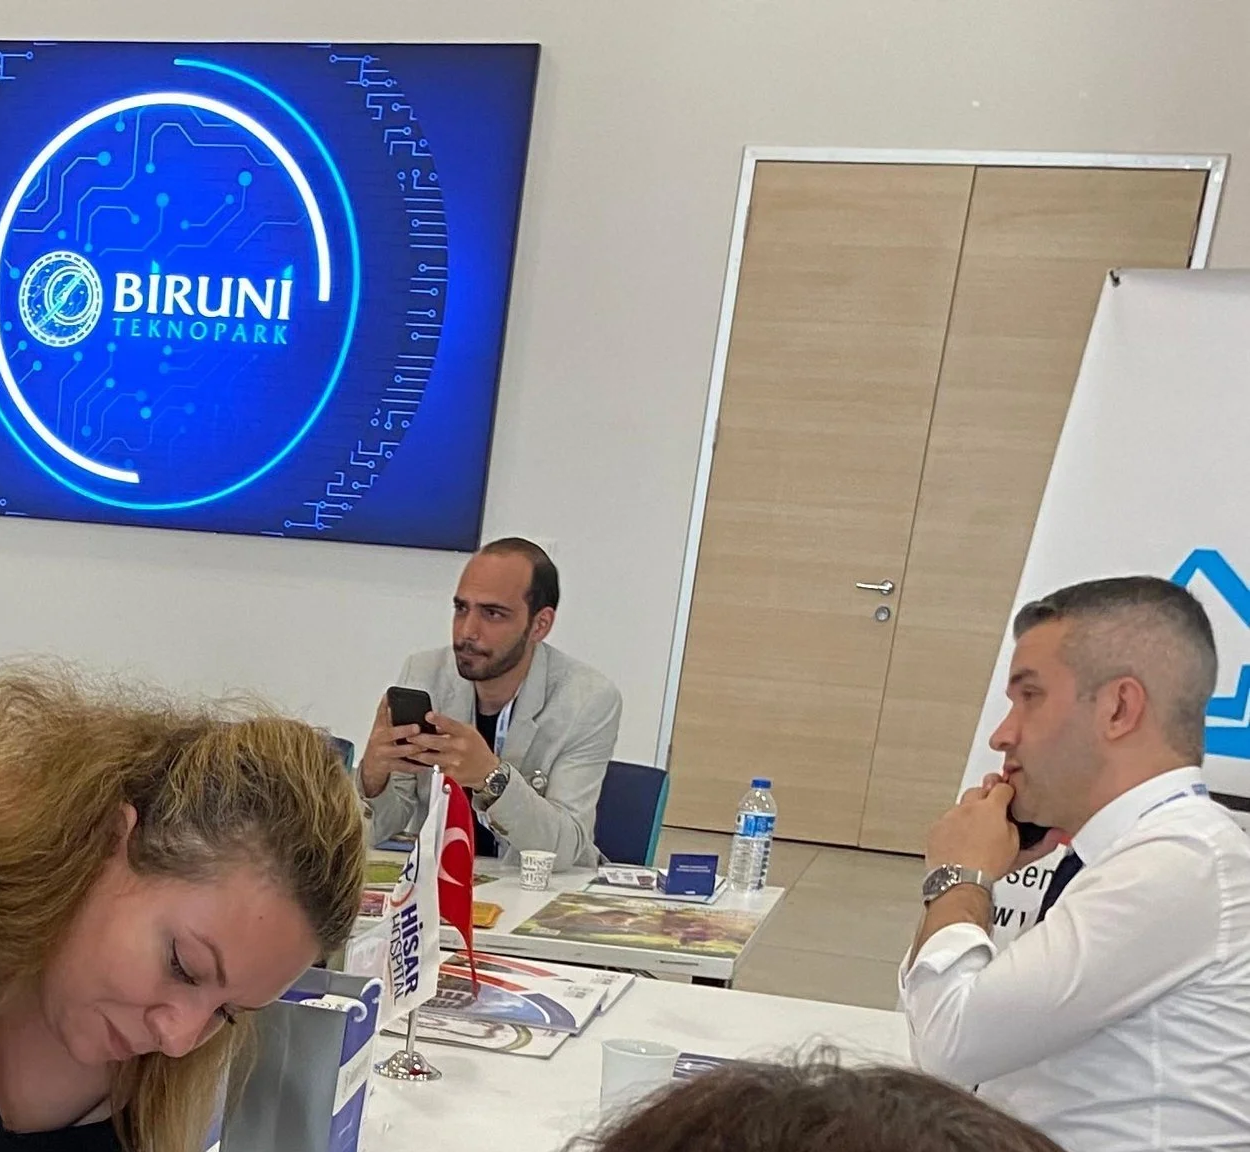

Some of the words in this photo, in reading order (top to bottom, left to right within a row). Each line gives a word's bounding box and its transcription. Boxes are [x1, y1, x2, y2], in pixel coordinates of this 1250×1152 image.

[113, 260, 294, 321] BİRUNİ
[112, 317, 287, 345] TEKNOPARK
[401, 903, 424, 998] HİSAR
